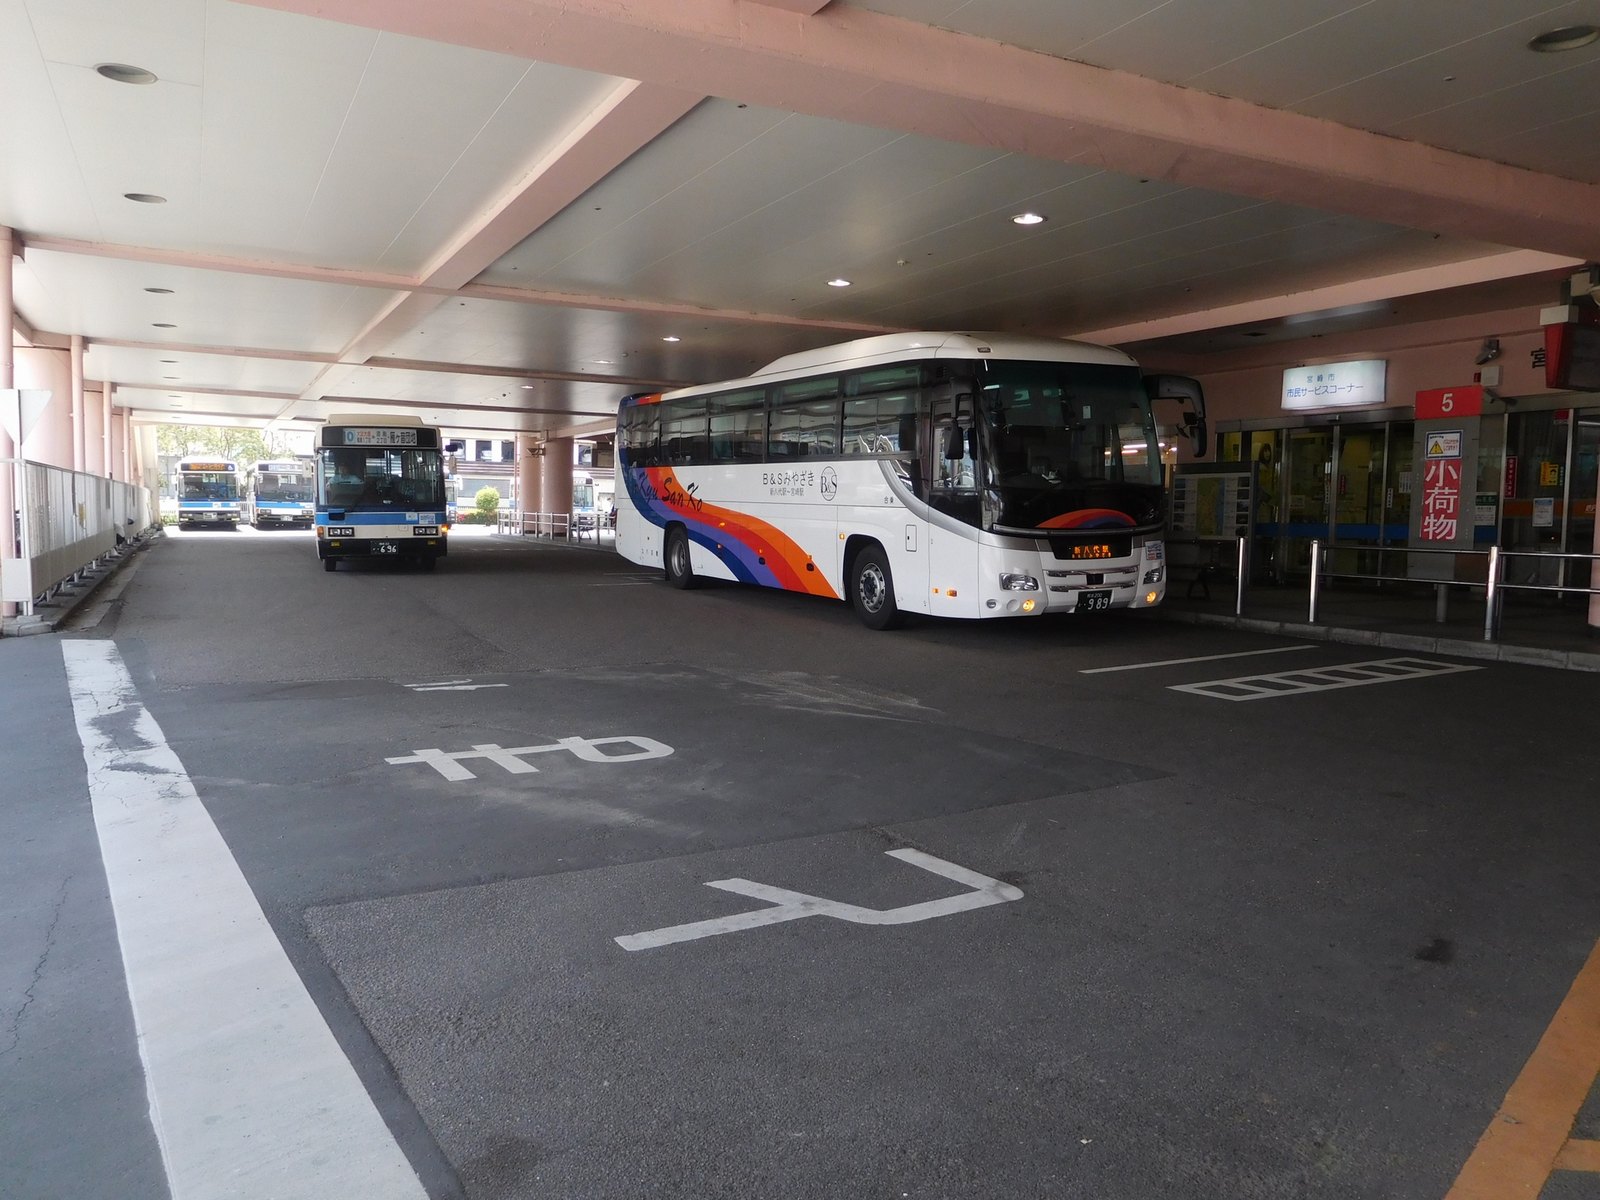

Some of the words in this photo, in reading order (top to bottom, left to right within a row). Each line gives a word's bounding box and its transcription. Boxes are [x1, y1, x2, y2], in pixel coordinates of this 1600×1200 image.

[1286, 382, 1365, 398] 市民サービスコーナー
[1441, 392, 1454, 413] 5
[762, 470, 815, 487] B&Sみやざき
[662, 476, 684, 508] San
[1424, 460, 1459, 540] 小荷物
[380, 545, 397, 553] 696
[1087, 597, 1109, 610] 989
